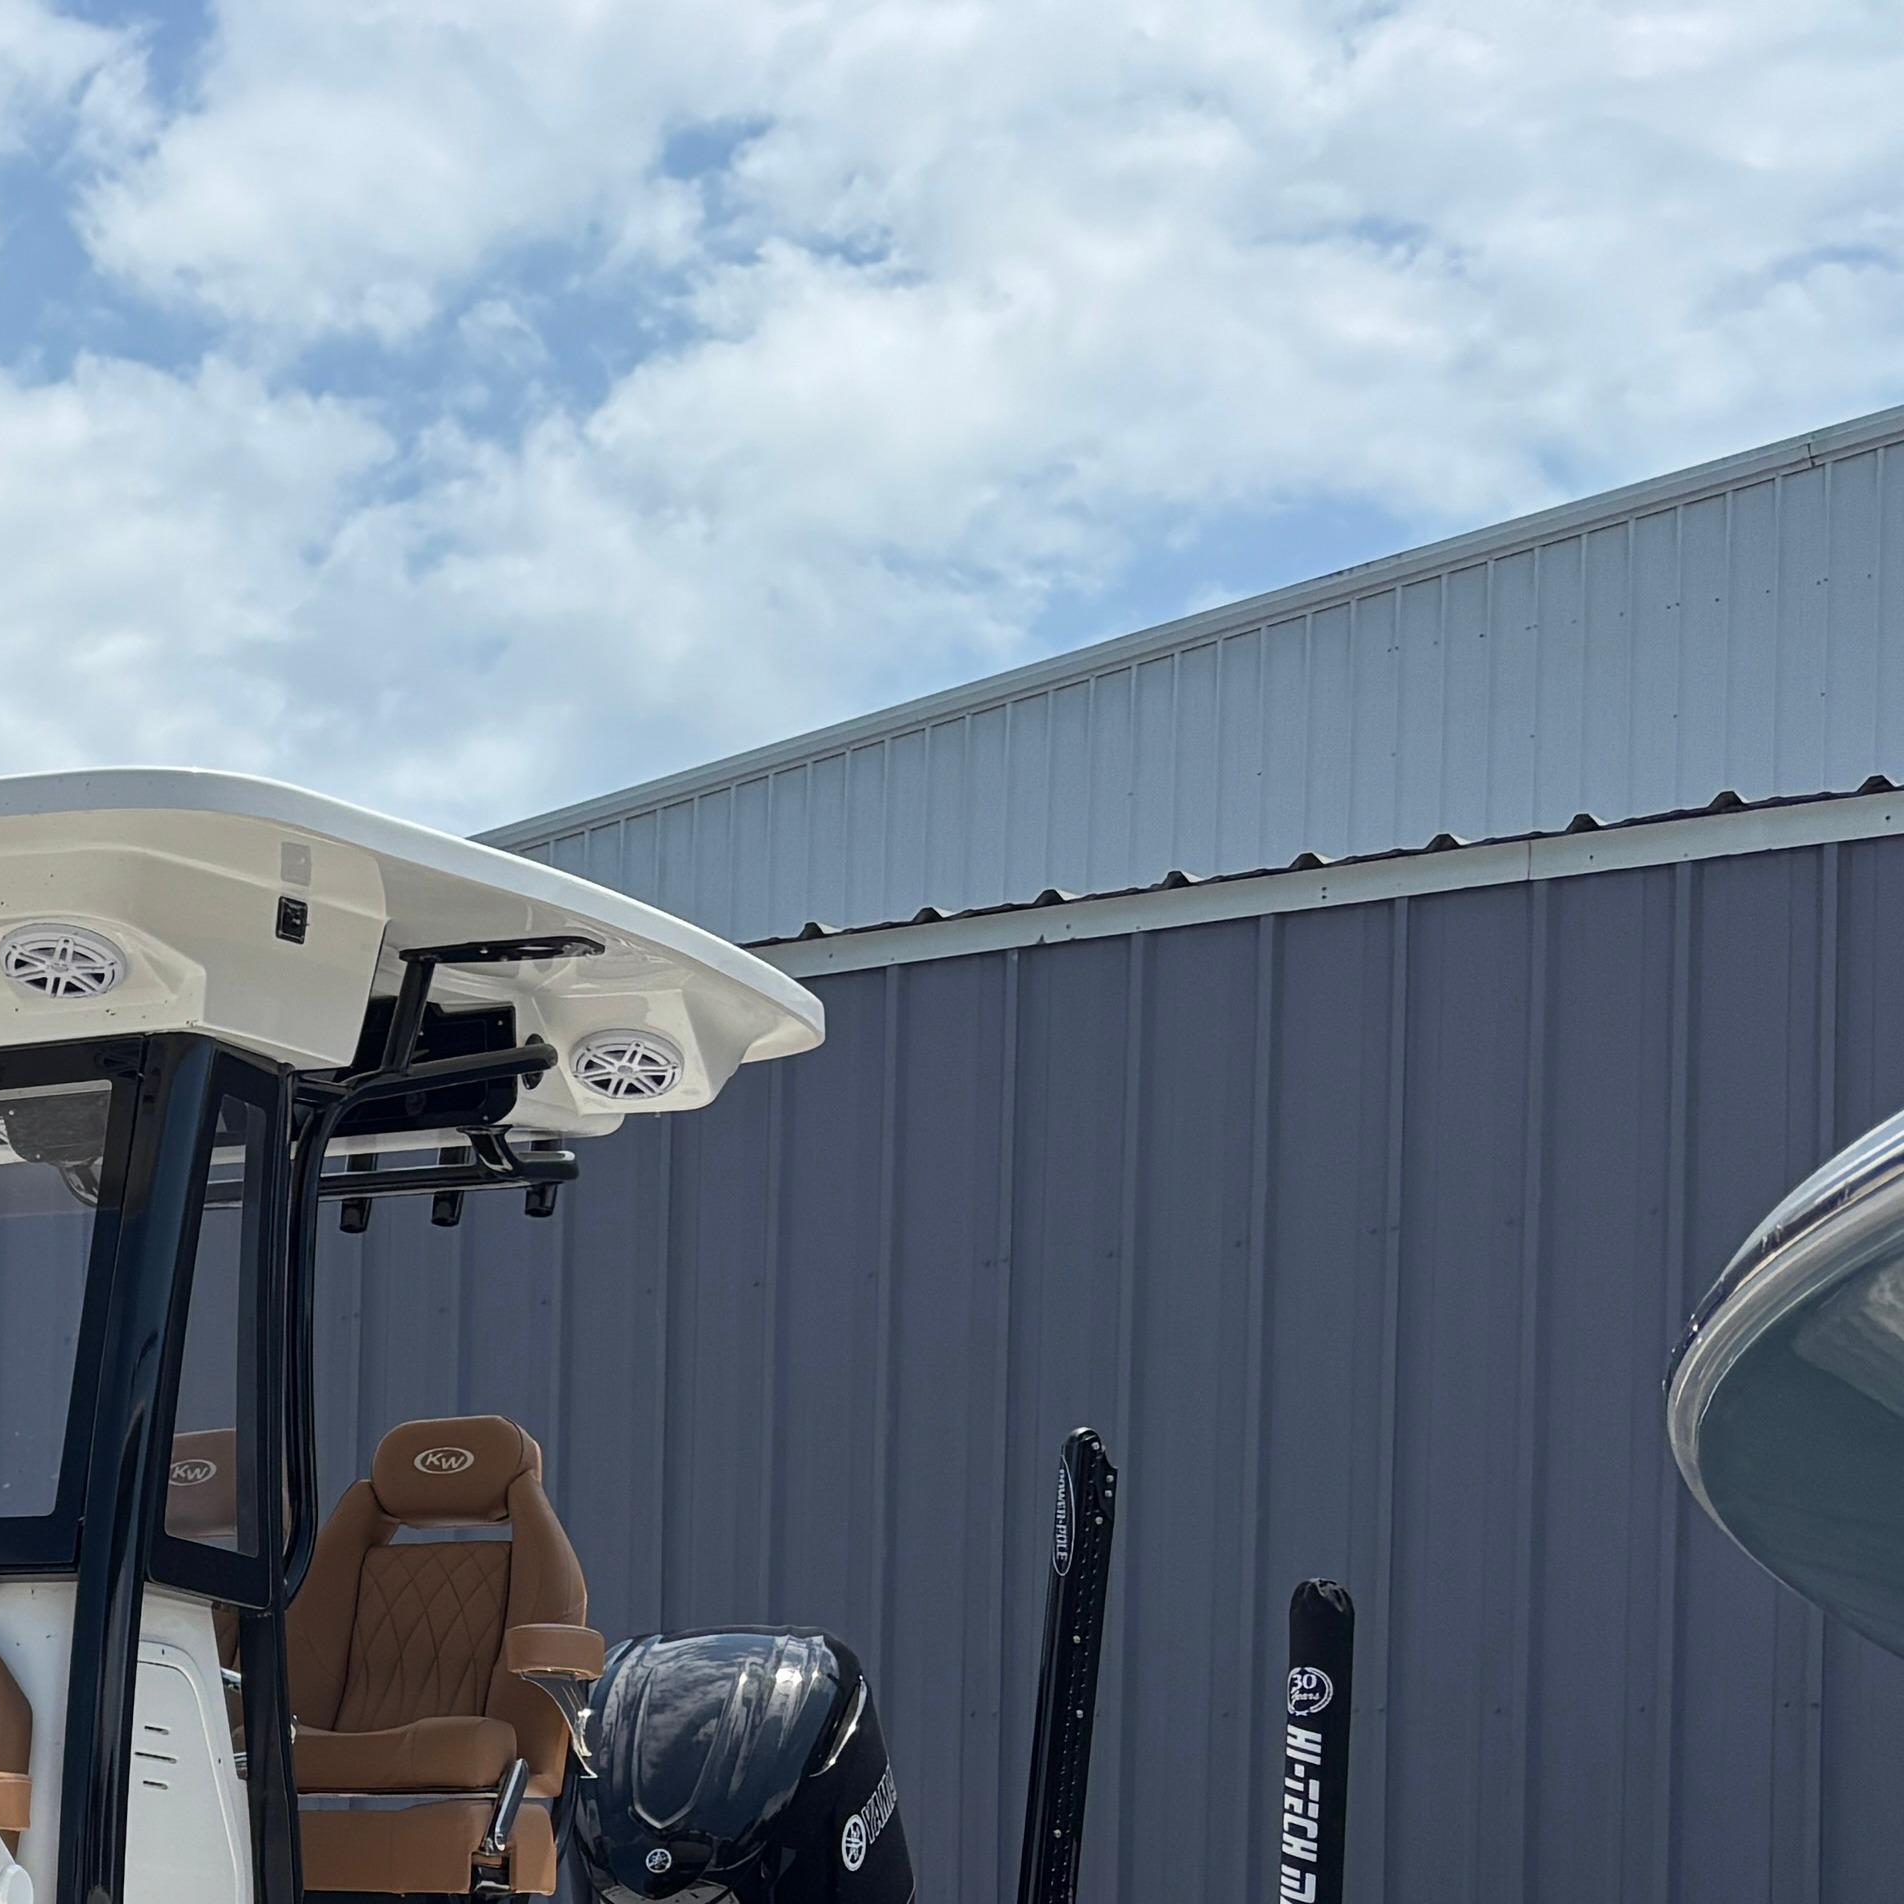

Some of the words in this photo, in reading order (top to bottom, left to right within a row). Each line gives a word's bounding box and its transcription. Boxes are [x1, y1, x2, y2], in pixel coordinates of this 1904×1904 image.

[1291, 1673, 1318, 1690] 30
[861, 1764, 897, 1844] YAM
[1281, 1723, 1323, 1863] HI-TECH
